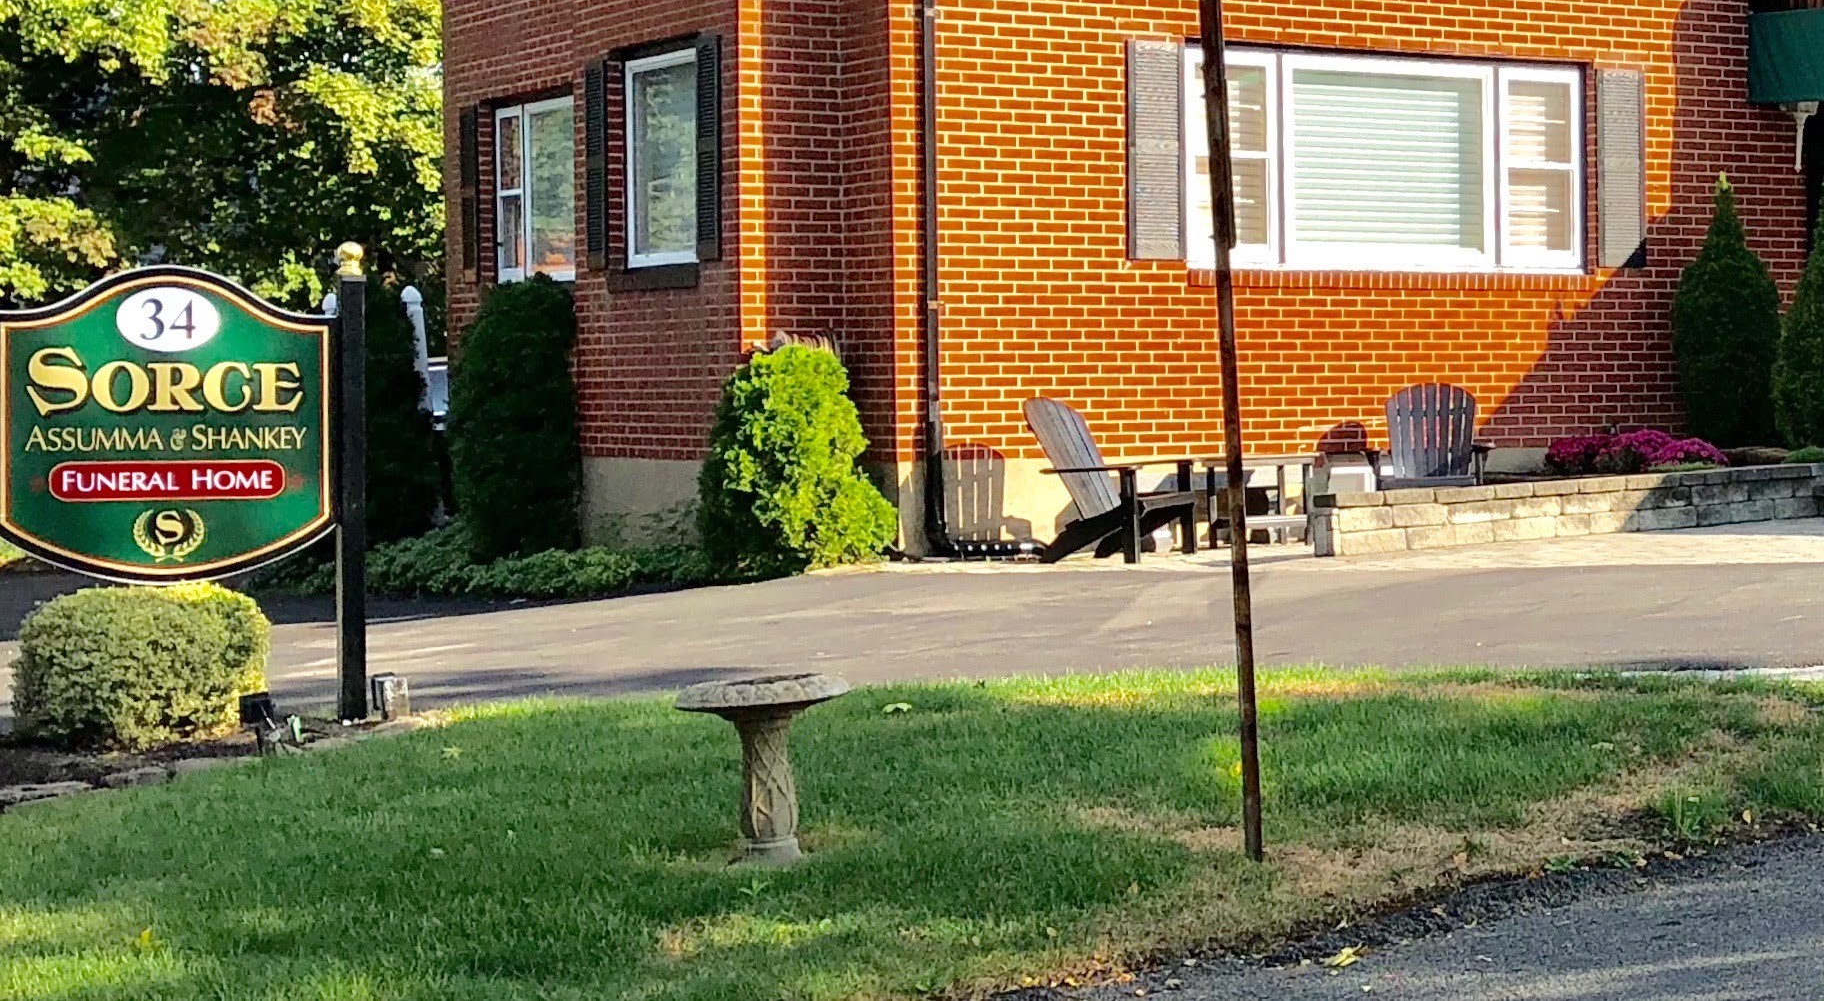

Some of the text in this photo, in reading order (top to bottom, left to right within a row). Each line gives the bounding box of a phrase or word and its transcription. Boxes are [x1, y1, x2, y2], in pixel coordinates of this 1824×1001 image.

[140, 298, 196, 340] 34
[26, 346, 303, 416] SORCE
[25, 424, 307, 451] ASSUMMA & SHANKEY
[62, 469, 273, 492] FUNERAL HOME
[155, 510, 184, 544] S
